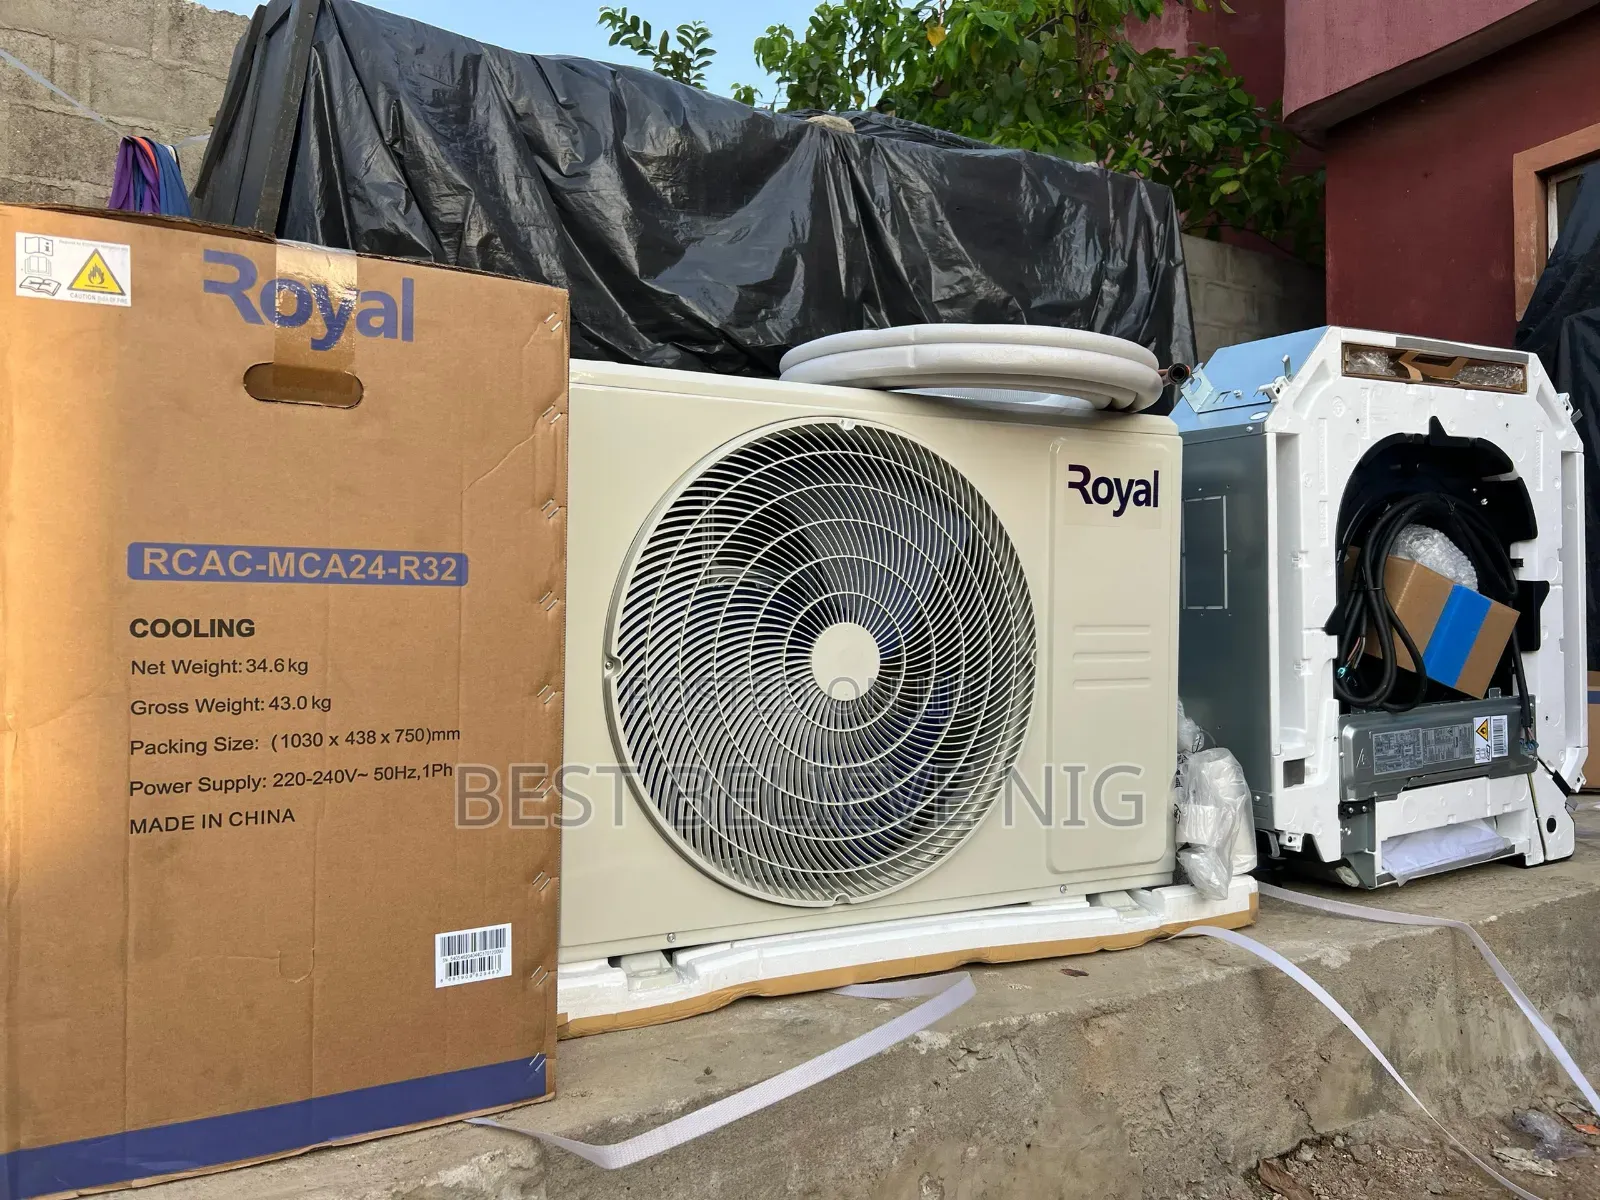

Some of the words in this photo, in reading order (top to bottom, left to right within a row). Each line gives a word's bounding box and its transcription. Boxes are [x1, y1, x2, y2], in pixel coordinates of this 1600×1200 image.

[203, 248, 415, 352] Royal
[1067, 463, 1160, 518] Royal
[143, 547, 457, 581] RCAC-MCA24-R32
[129, 618, 256, 638] COOLING
[131, 659, 166, 675] Net
[172, 658, 243, 677] Weight:
[130, 700, 189, 715] Gross
[195, 697, 265, 717] Weight:
[130, 738, 207, 756] Packing
[213, 736, 259, 752] Size:
[328, 735, 339, 747] x
[345, 730, 377, 745] 438
[380, 733, 391, 744] x
[130, 779, 192, 796] Power
[197, 774, 268, 794] Supply:
[272, 769, 369, 788] 220-240V~
[373, 763, 453, 782] 50Hz,1Ph
[130, 815, 195, 835] MADE
[201, 812, 223, 829] IN
[229, 808, 296, 827] CHINA
